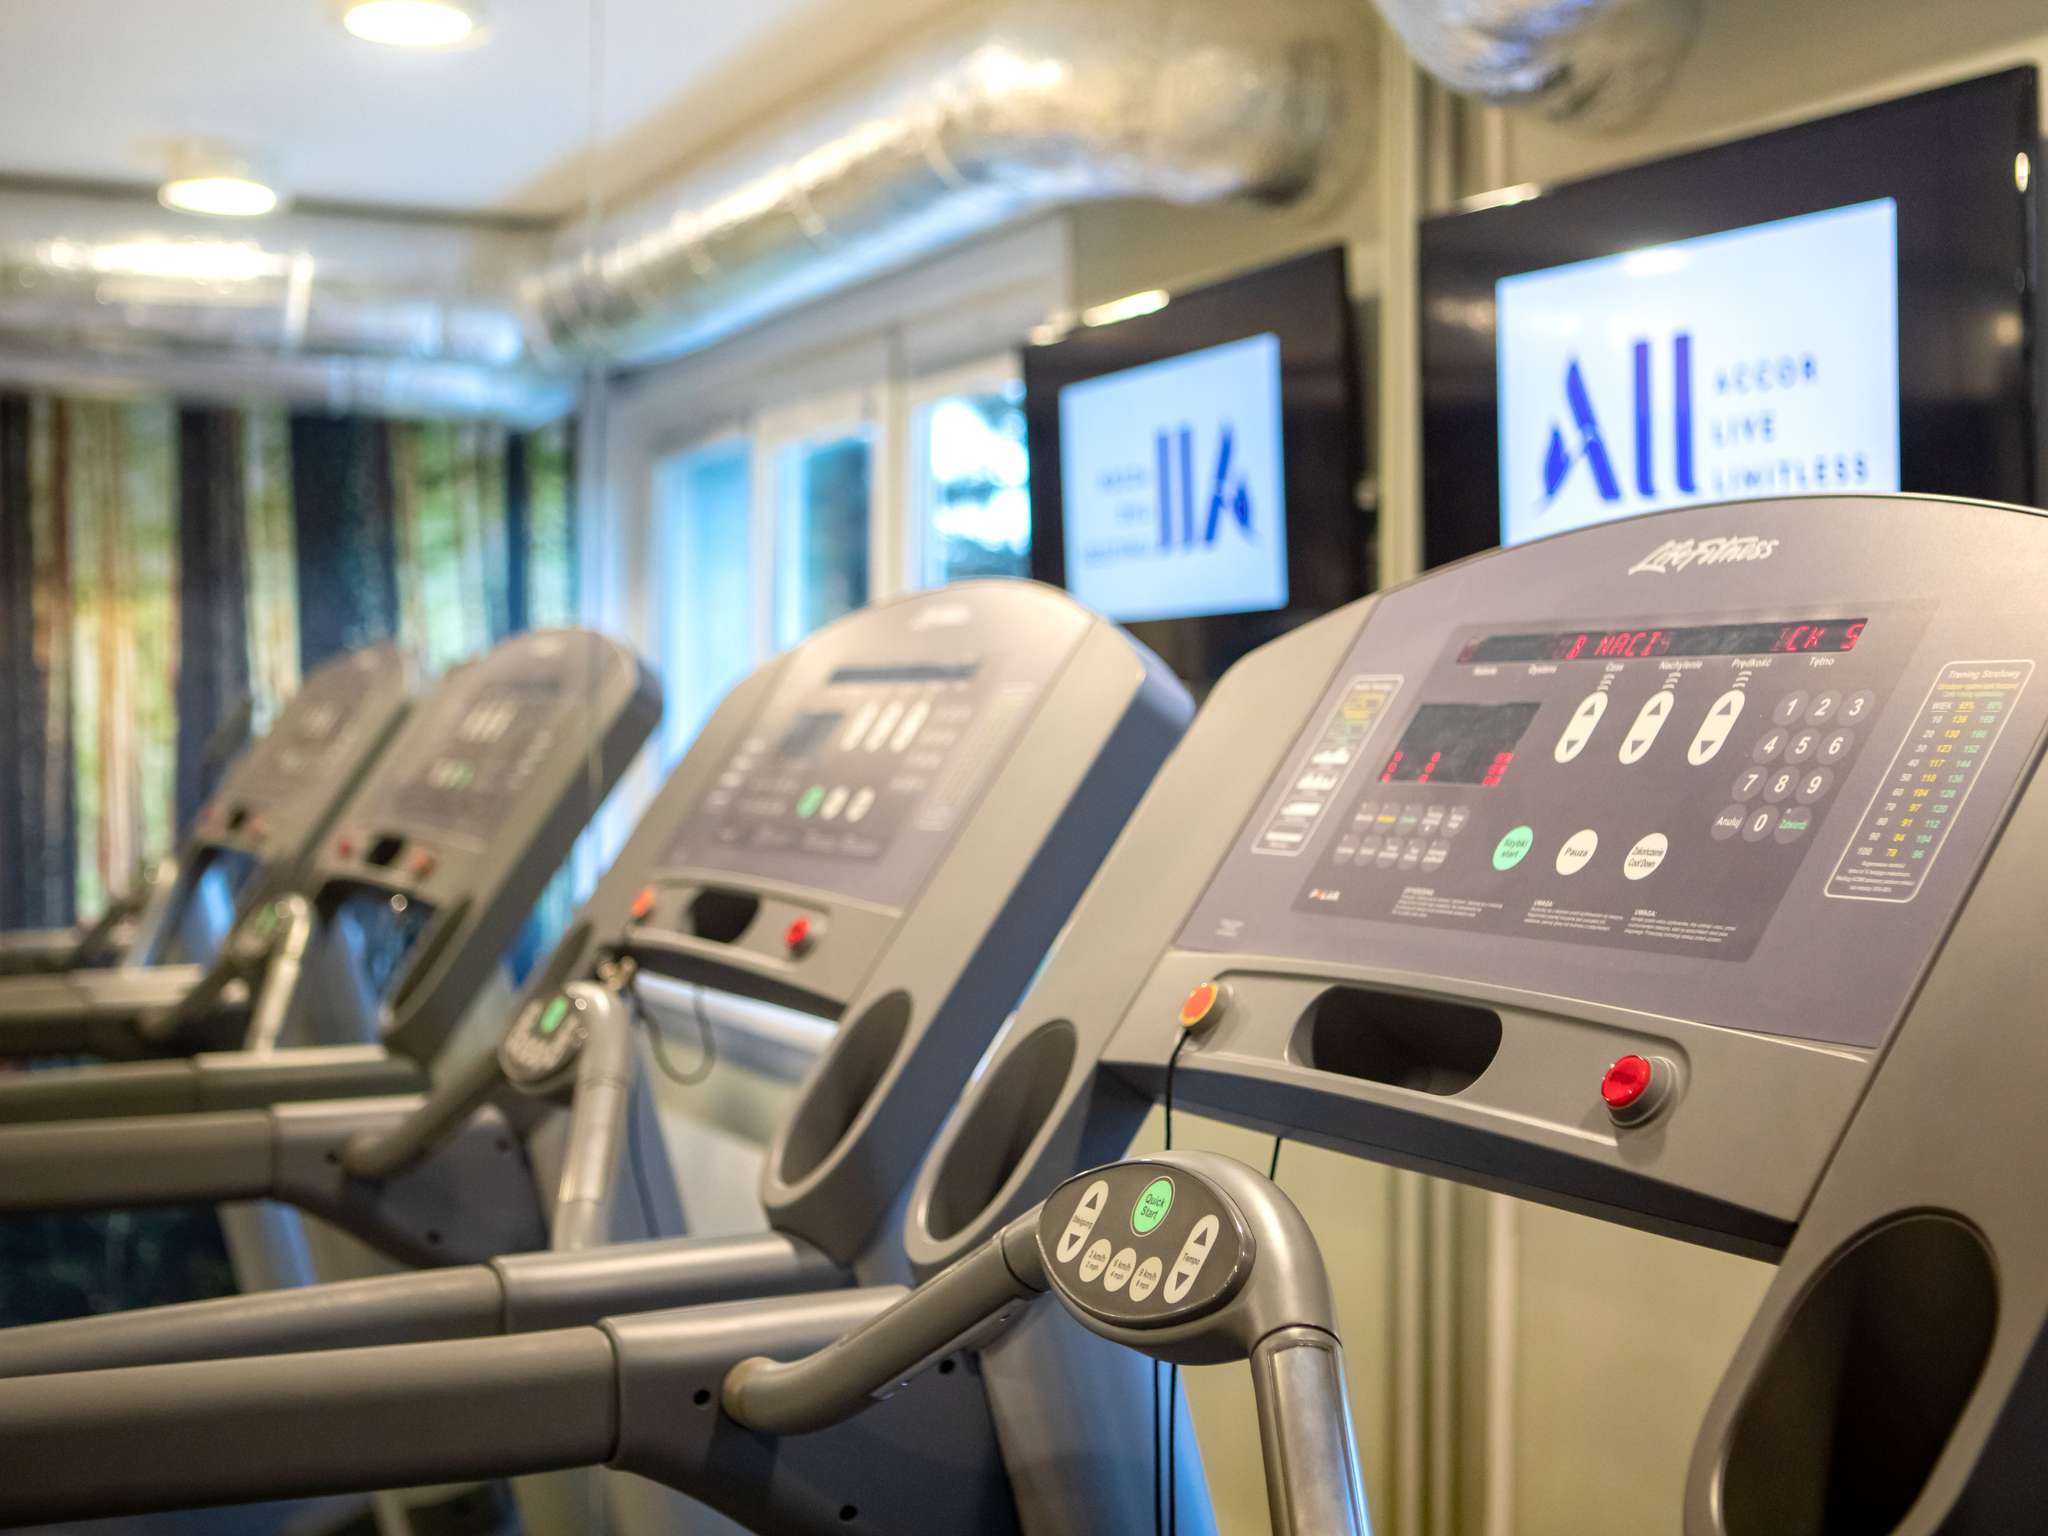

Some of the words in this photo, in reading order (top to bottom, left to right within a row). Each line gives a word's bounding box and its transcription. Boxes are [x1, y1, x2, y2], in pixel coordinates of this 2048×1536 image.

[1713, 354, 1818, 395] ACCOR
[1711, 410, 1775, 448] LIVE
[1711, 453, 1868, 494] LIMITLESS
[1786, 698, 1798, 716] 1
[1814, 698, 1831, 716] 2
[1849, 698, 1864, 716] 3
[1763, 735, 1779, 753] 4
[1795, 736, 1812, 754] 5
[1828, 737, 1844, 755] 6
[1743, 774, 1759, 792] 7
[1774, 775, 1789, 793] 8
[1806, 776, 1822, 794] 9
[1753, 814, 1768, 832] 0
[1564, 847, 1588, 857] Pauza
[1146, 1194, 1165, 1208] Quick
[1141, 1206, 1158, 1220] Start
